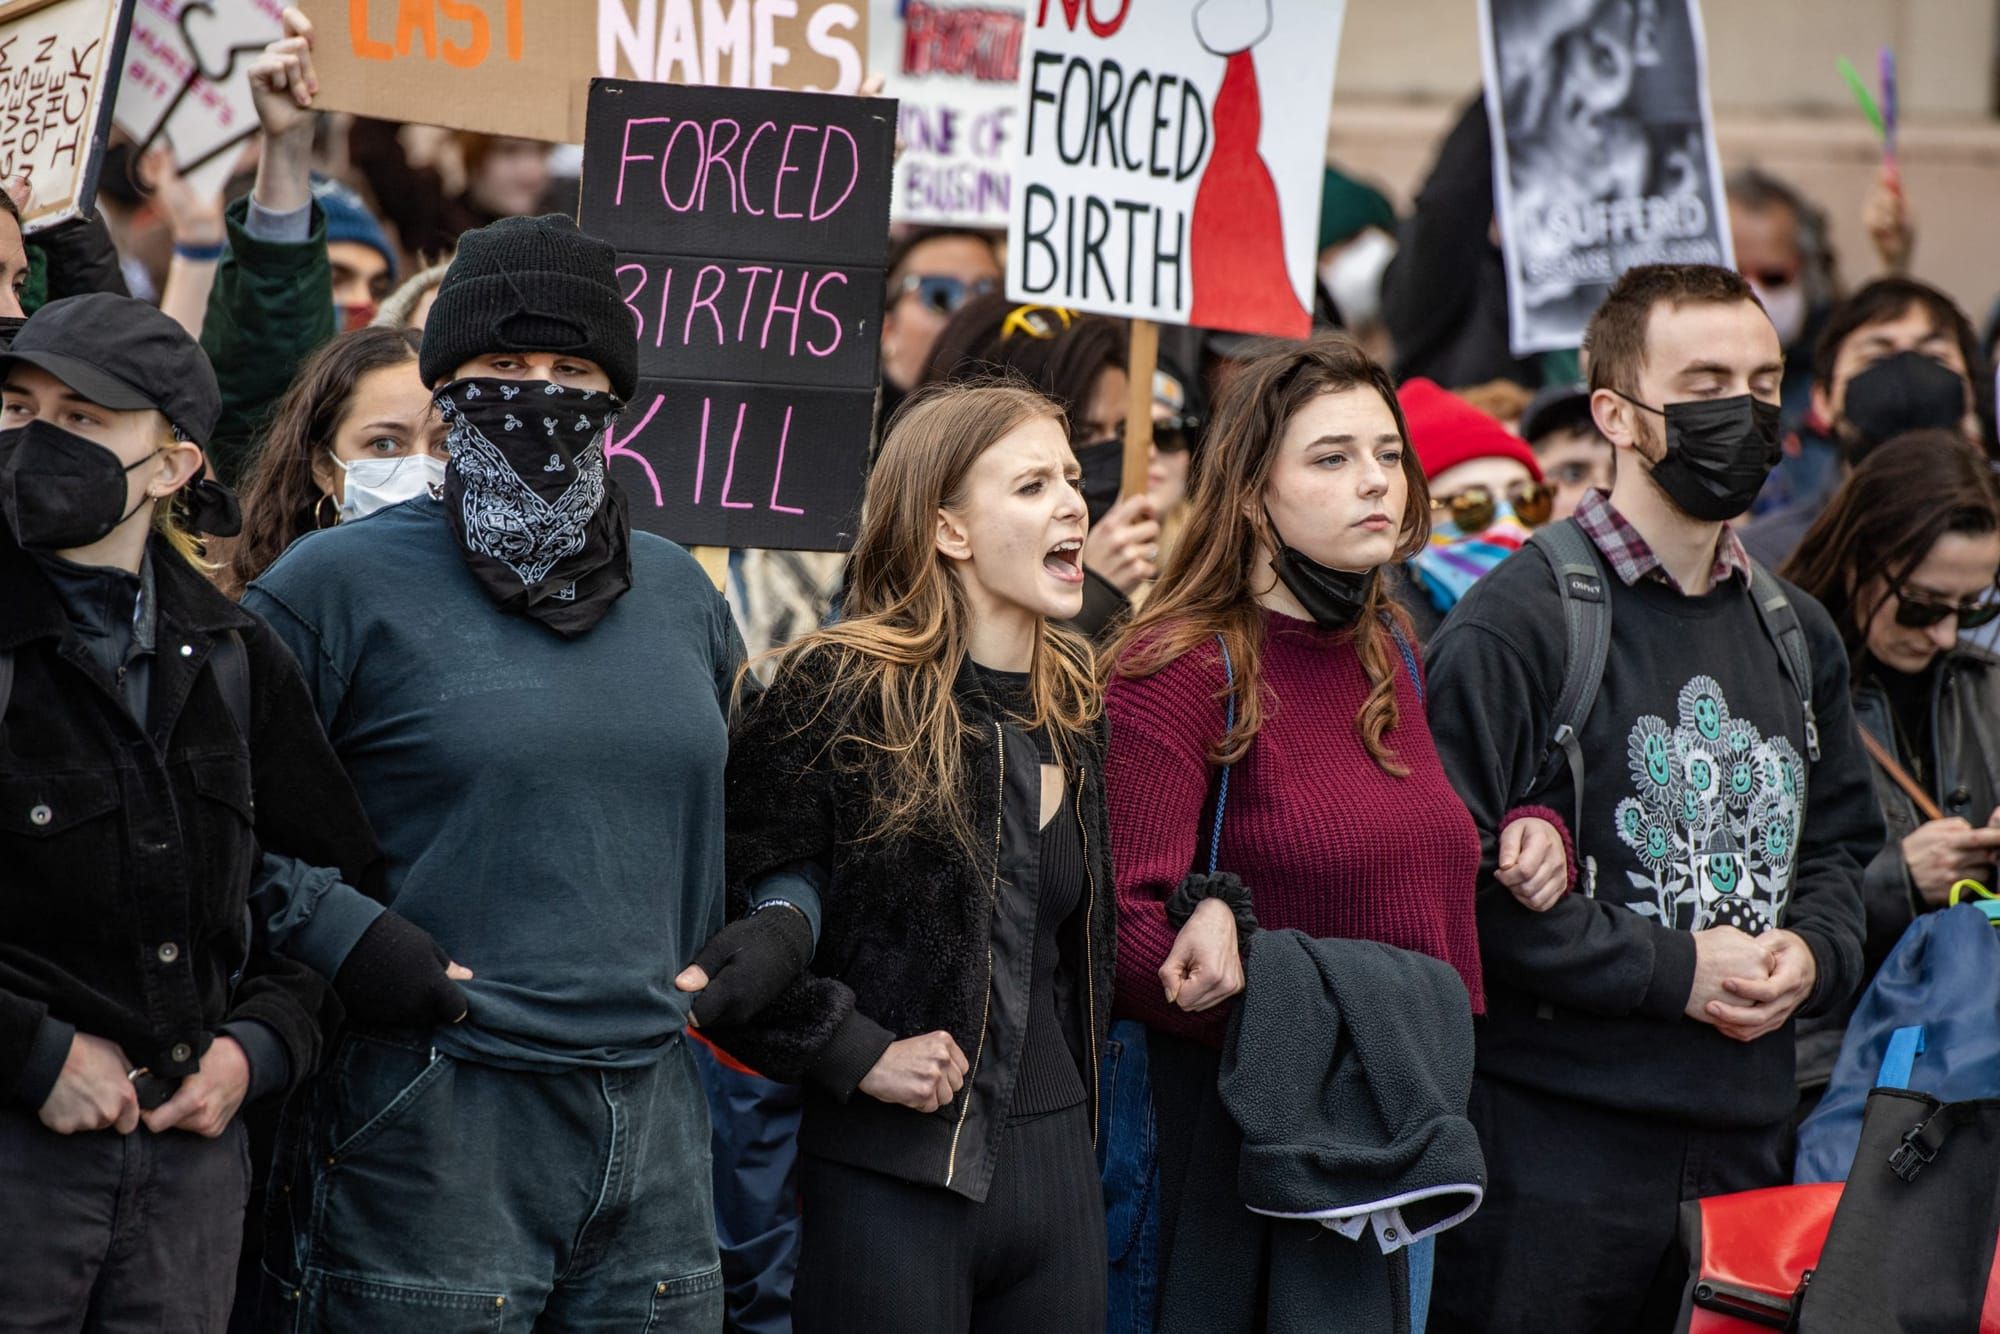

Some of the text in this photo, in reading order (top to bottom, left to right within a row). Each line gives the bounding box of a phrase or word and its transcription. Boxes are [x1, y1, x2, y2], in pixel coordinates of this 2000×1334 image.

[51, 38, 100, 168] ICK
[597, 0, 862, 97] NAMES
[41, 70, 67, 141] THE
[1026, 50, 1207, 183] FORCED
[615, 117, 859, 221] FORCED
[1022, 183, 1185, 311] BIRTH
[615, 263, 848, 357] BIRTHS
[604, 394, 804, 515] KILL
